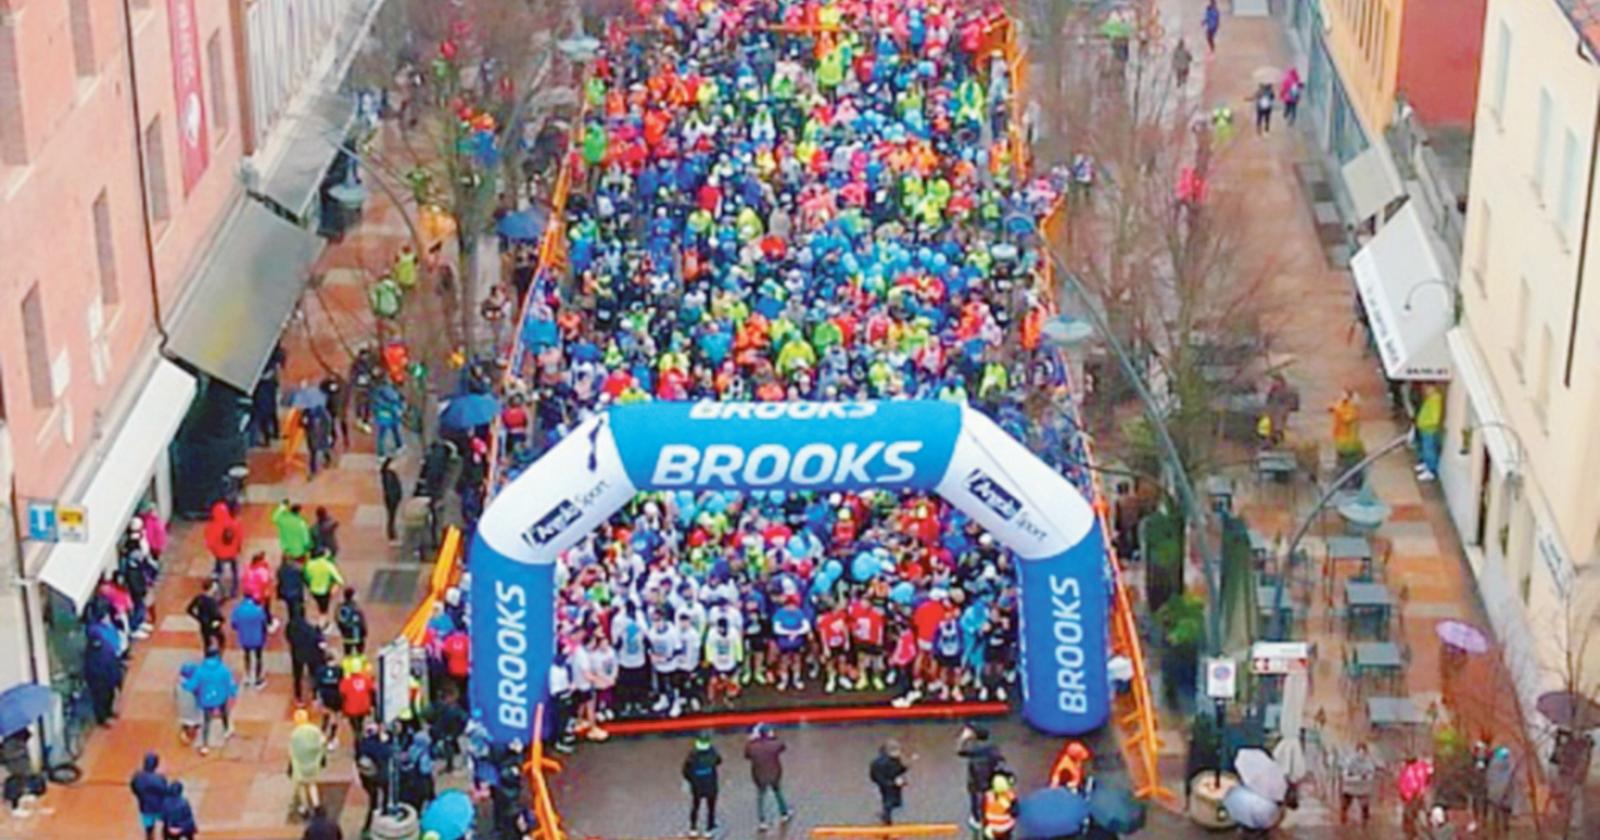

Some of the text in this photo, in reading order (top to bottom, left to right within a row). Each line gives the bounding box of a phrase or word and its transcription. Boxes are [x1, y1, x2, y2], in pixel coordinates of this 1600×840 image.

[689, 400, 877, 419] BROOKS
[651, 441, 923, 485] BROOKS
[496, 580, 528, 729] BROOKS
[1049, 574, 1088, 714] BROOKS
